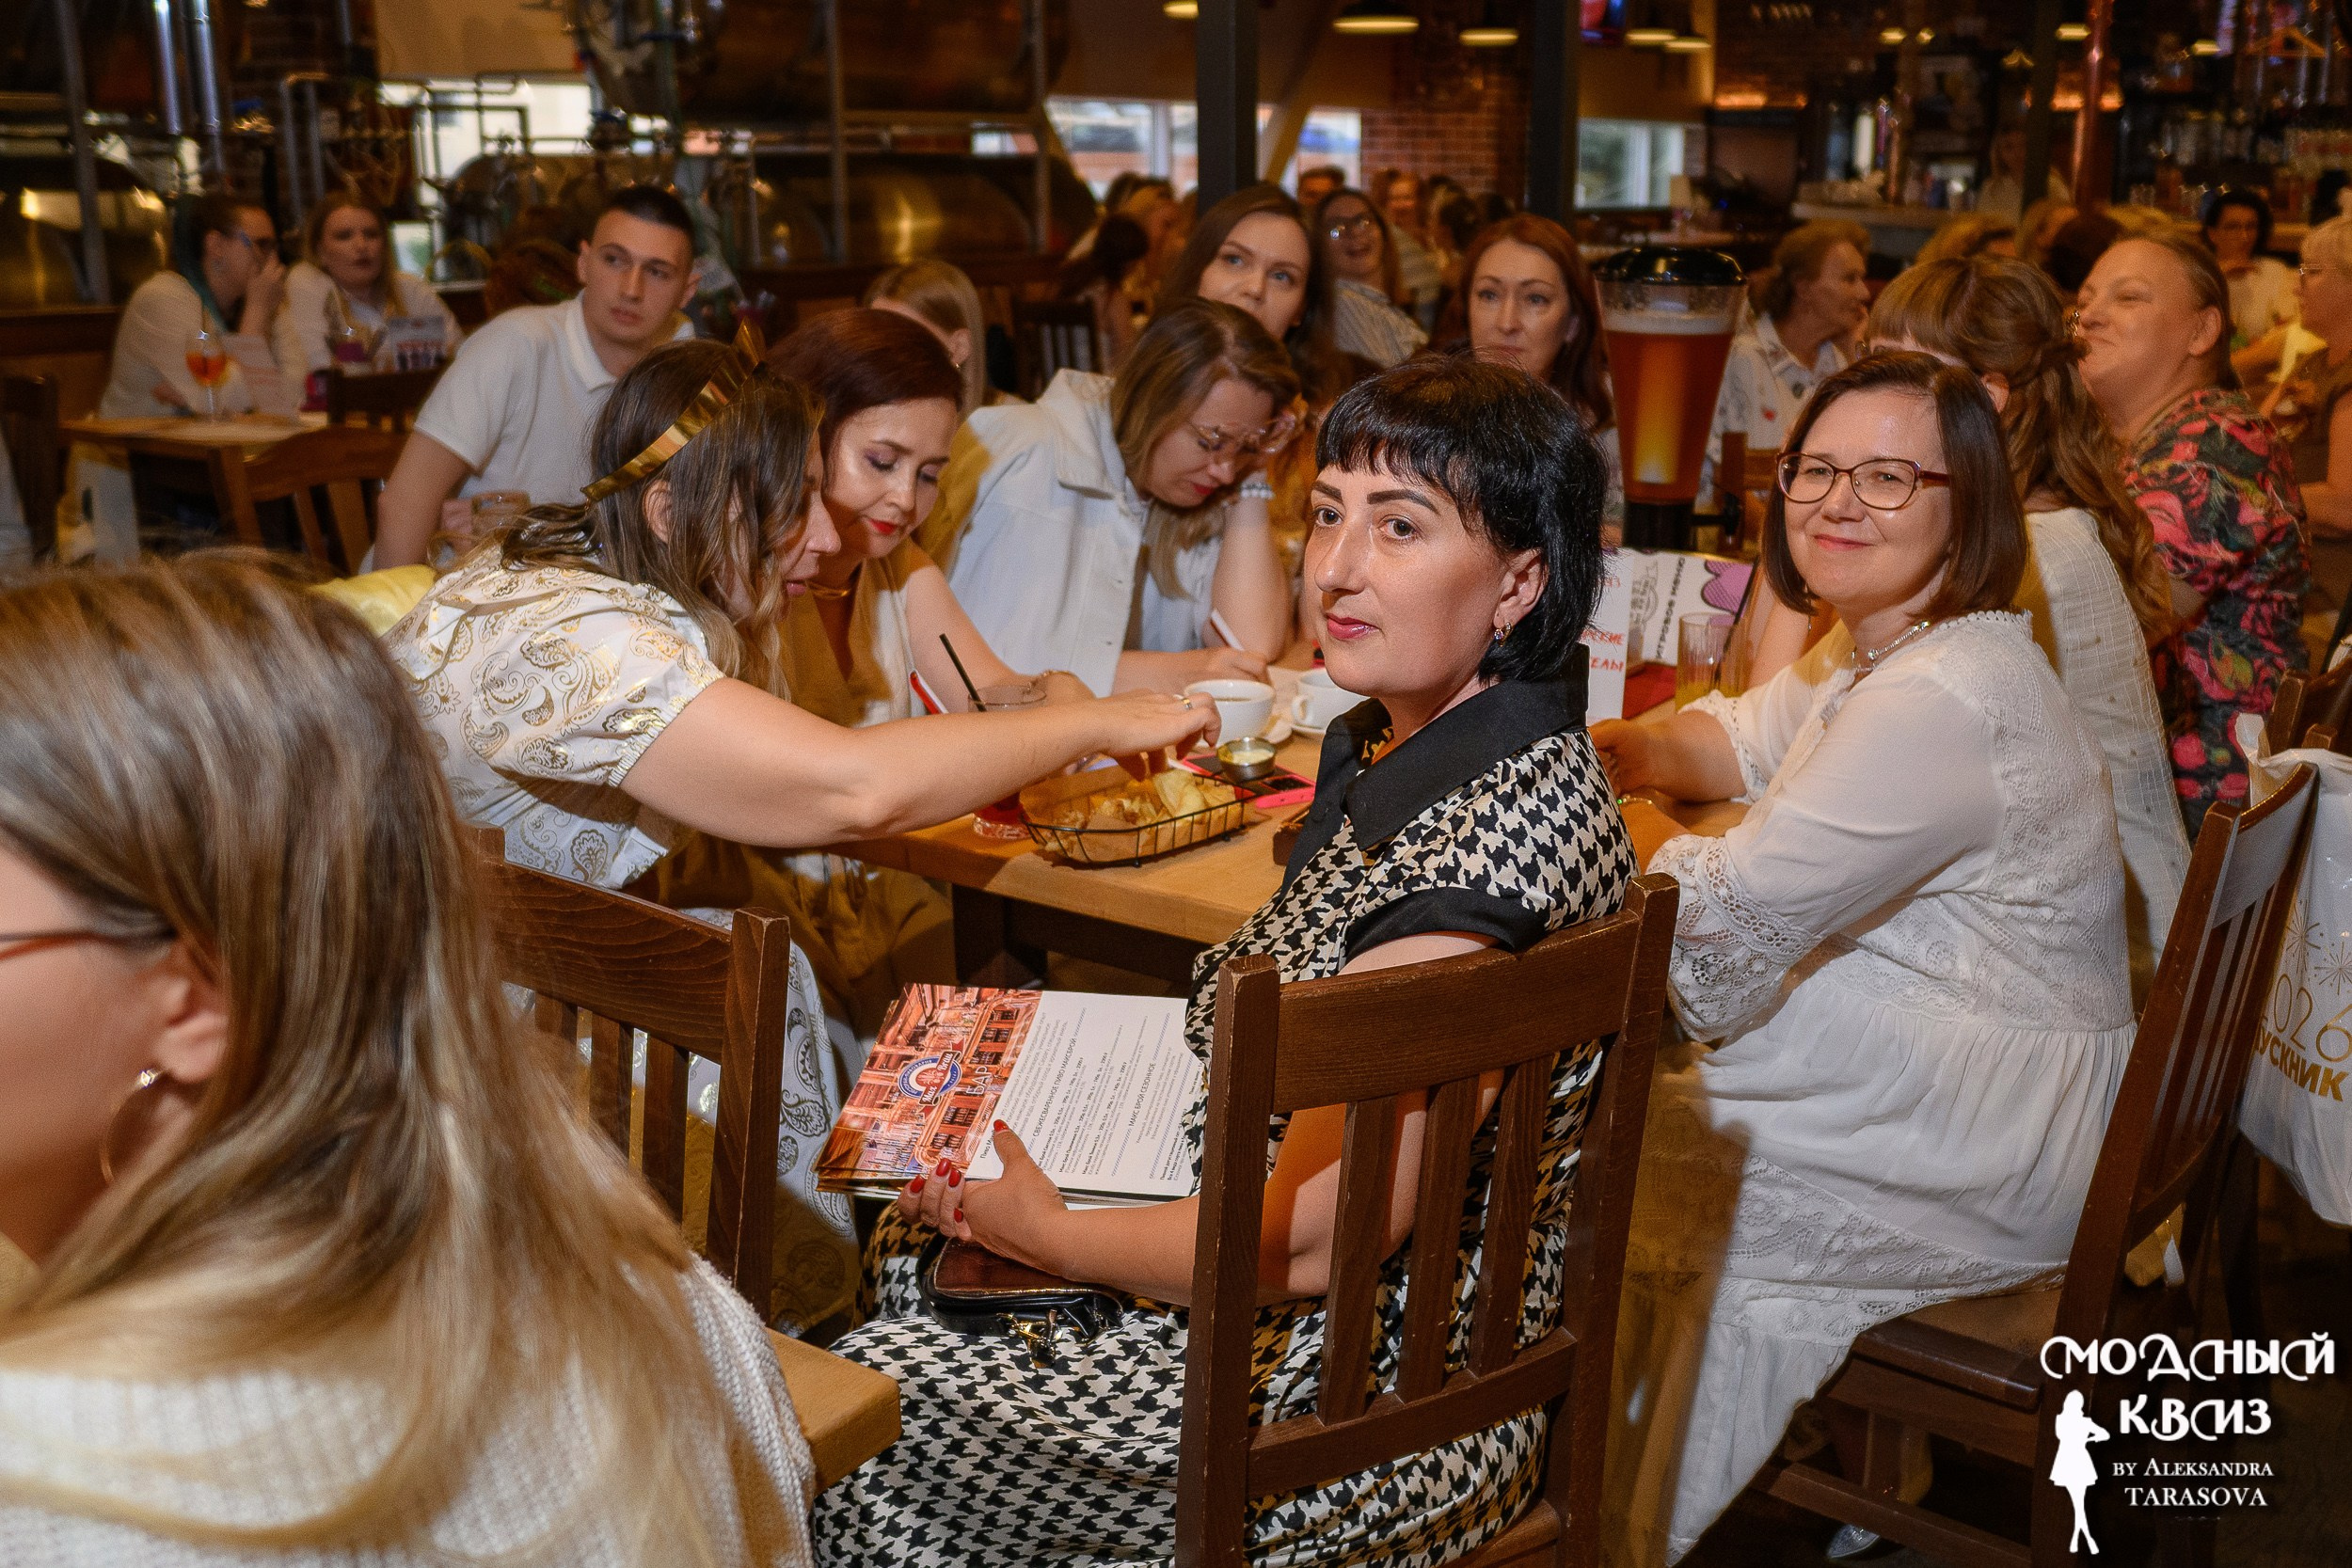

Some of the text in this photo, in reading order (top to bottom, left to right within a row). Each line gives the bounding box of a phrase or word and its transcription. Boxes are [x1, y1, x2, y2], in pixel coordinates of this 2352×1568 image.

[2262, 974, 2352, 1063] 026
[966, 1066, 989, 1094] БАР
[1034, 1086, 1057, 1135] СВЕЖЕСВАРЕННОЕ
[1053, 1069, 1065, 1084] ПИВО
[1060, 1037, 1077, 1068] МАКСБРОЙ
[1127, 1063, 1156, 1126] МАКС БРОЙ СЕЗОННОЕ
[979, 1146, 990, 1158] Пиво
